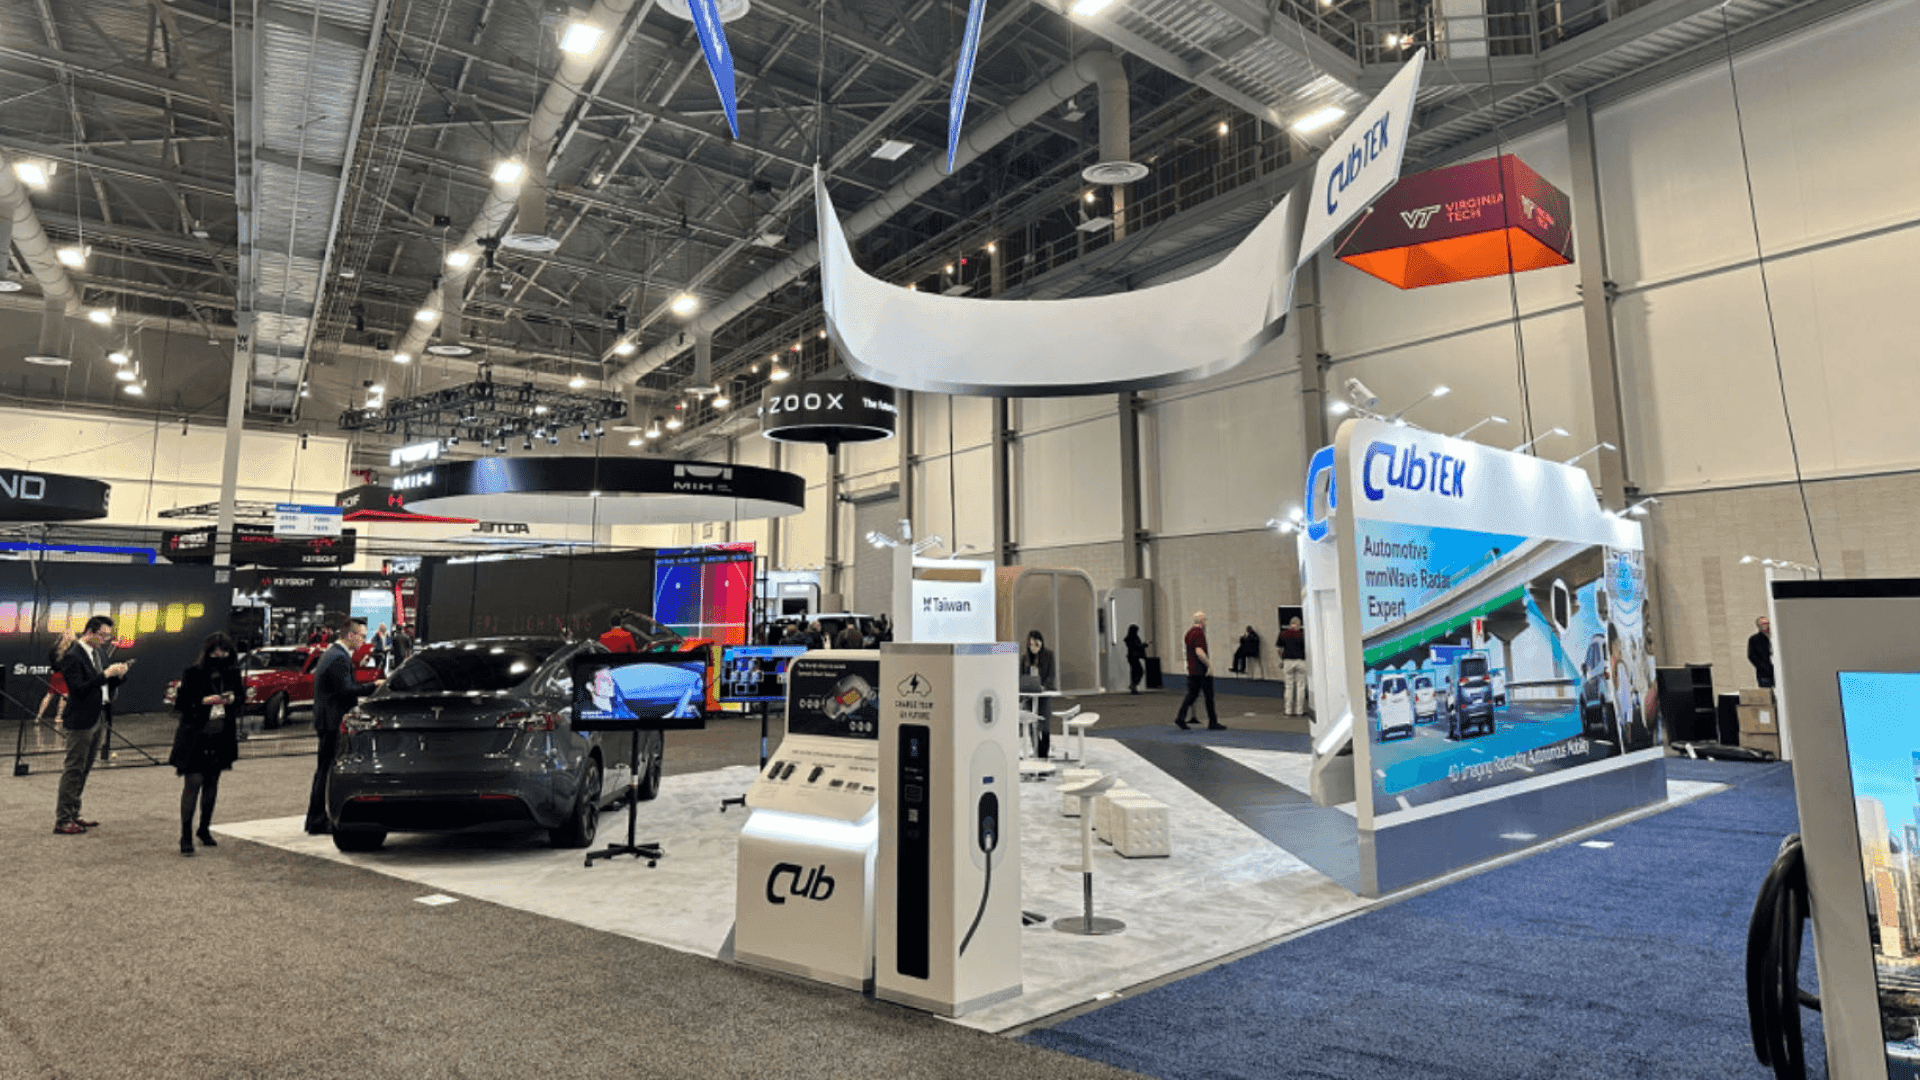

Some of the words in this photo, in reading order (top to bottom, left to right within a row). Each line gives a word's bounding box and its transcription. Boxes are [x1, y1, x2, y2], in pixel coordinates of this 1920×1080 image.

[1445, 193, 1503, 212] VIRGINIA
[1399, 204, 1442, 229] VT
[1447, 209, 1481, 222] TECH
[768, 392, 844, 414] ZOOX
[393, 471, 434, 491] MIH
[673, 482, 713, 491] MIH
[1363, 535, 1428, 560] Automotive
[273, 578, 315, 586] KEYSIGHT
[1365, 566, 1418, 588] mmWave
[1420, 568, 1451, 588] Radar
[933, 597, 971, 612] Taiwan
[1367, 595, 1407, 622] Expert
[895, 700, 917, 709] CHARGE
[1461, 761, 1493, 782] Imaging
[1494, 756, 1515, 772] Radar
[1529, 744, 1566, 765] Autonomous
[1567, 738, 1590, 756] Mobility
[766, 863, 835, 905] Cub
